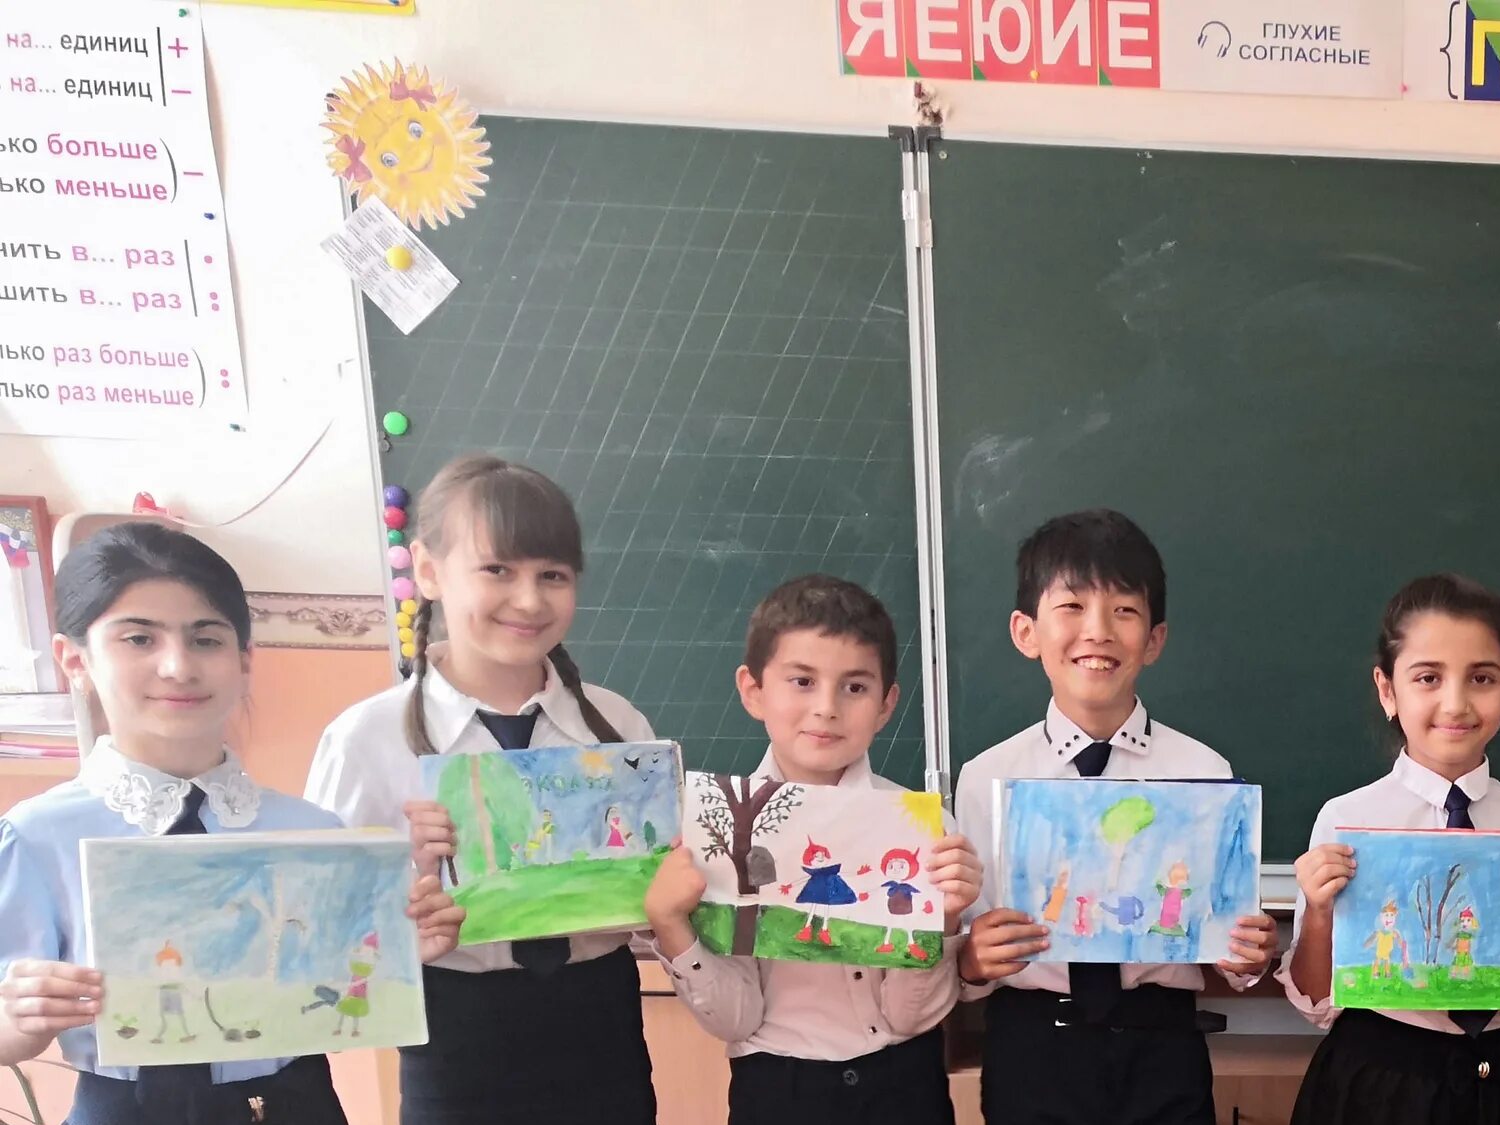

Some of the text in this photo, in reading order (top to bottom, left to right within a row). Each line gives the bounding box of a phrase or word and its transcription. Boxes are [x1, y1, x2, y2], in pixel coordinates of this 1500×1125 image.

[1262, 22, 1342, 42] ГЛУХИЕ
[60, 33, 149, 58] единиц
[1238, 44, 1371, 66] СОГЛАСНЫЕ
[64, 78, 153, 102] единиц
[47, 133, 158, 161] больше
[55, 179, 168, 201] меньше
[125, 248, 175, 269] раз
[132, 291, 182, 313] раз
[0, 343, 189, 368] ько раз больше
[58, 384, 96, 406] раз
[104, 386, 194, 406] меньше
